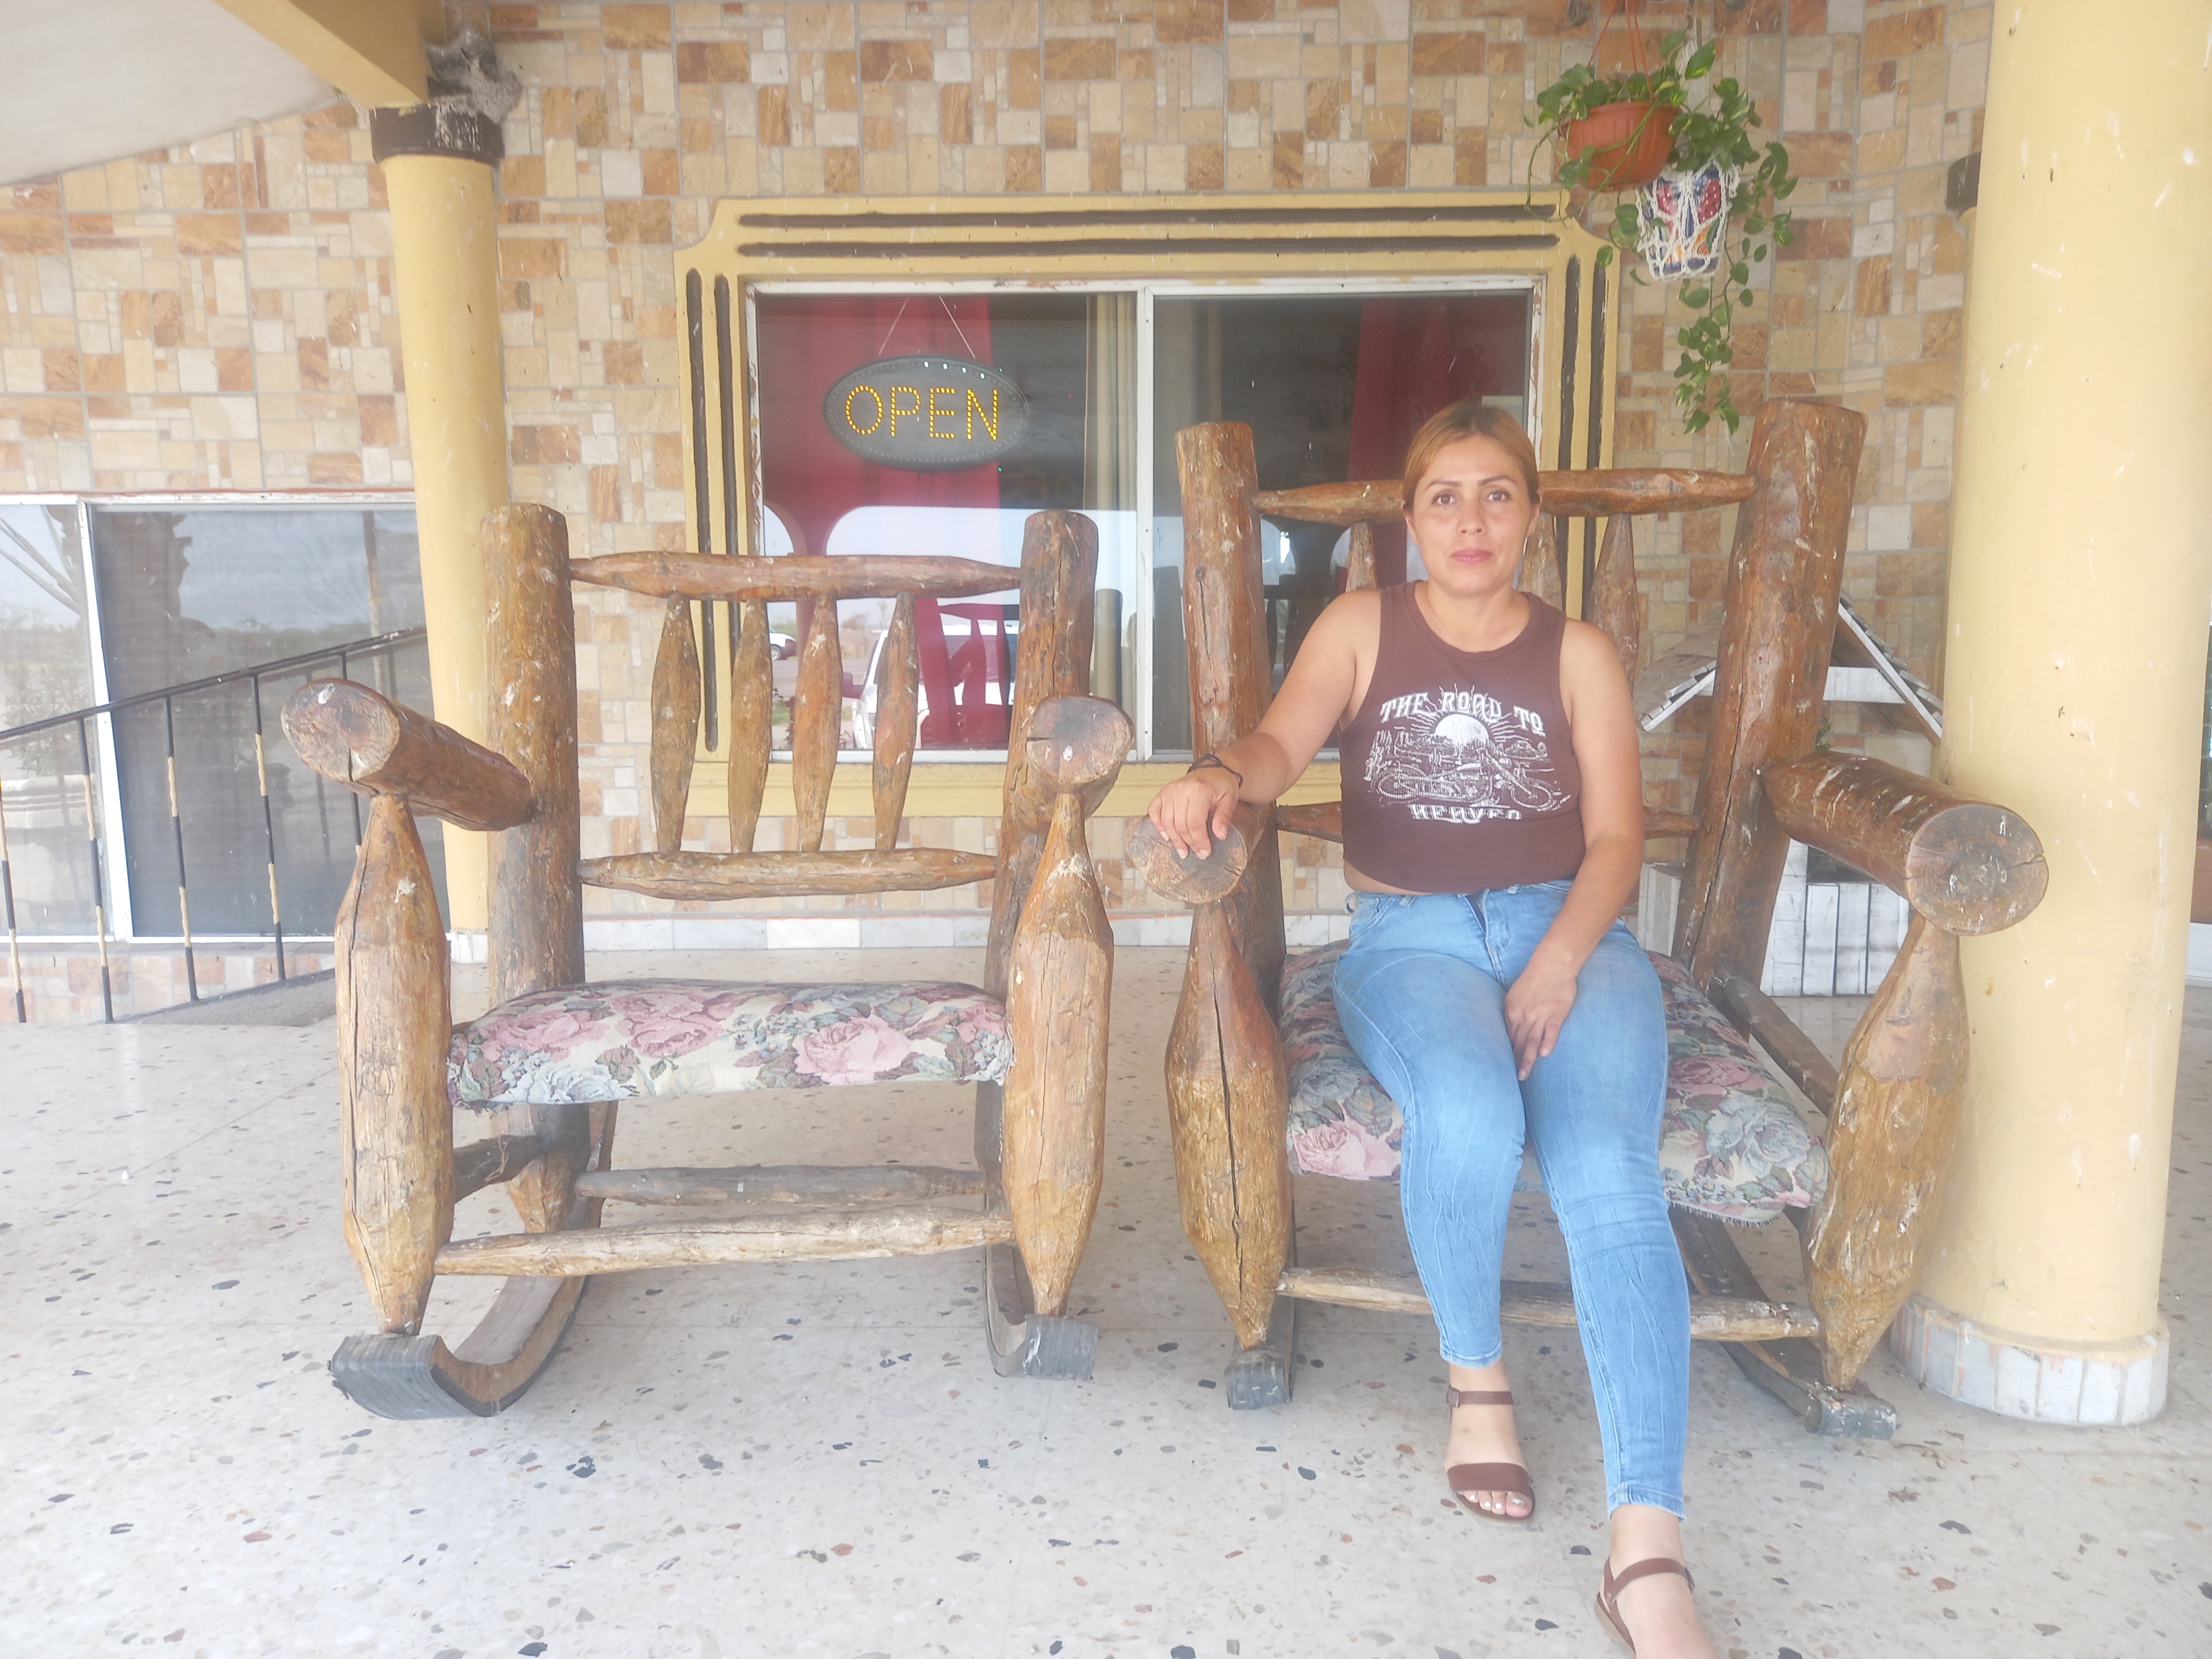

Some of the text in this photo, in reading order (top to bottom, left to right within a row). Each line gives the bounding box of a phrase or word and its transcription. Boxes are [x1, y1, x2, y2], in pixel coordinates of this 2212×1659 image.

[846, 385, 998, 440] OPEN
[1379, 691, 1546, 738] THE ROAD TO
